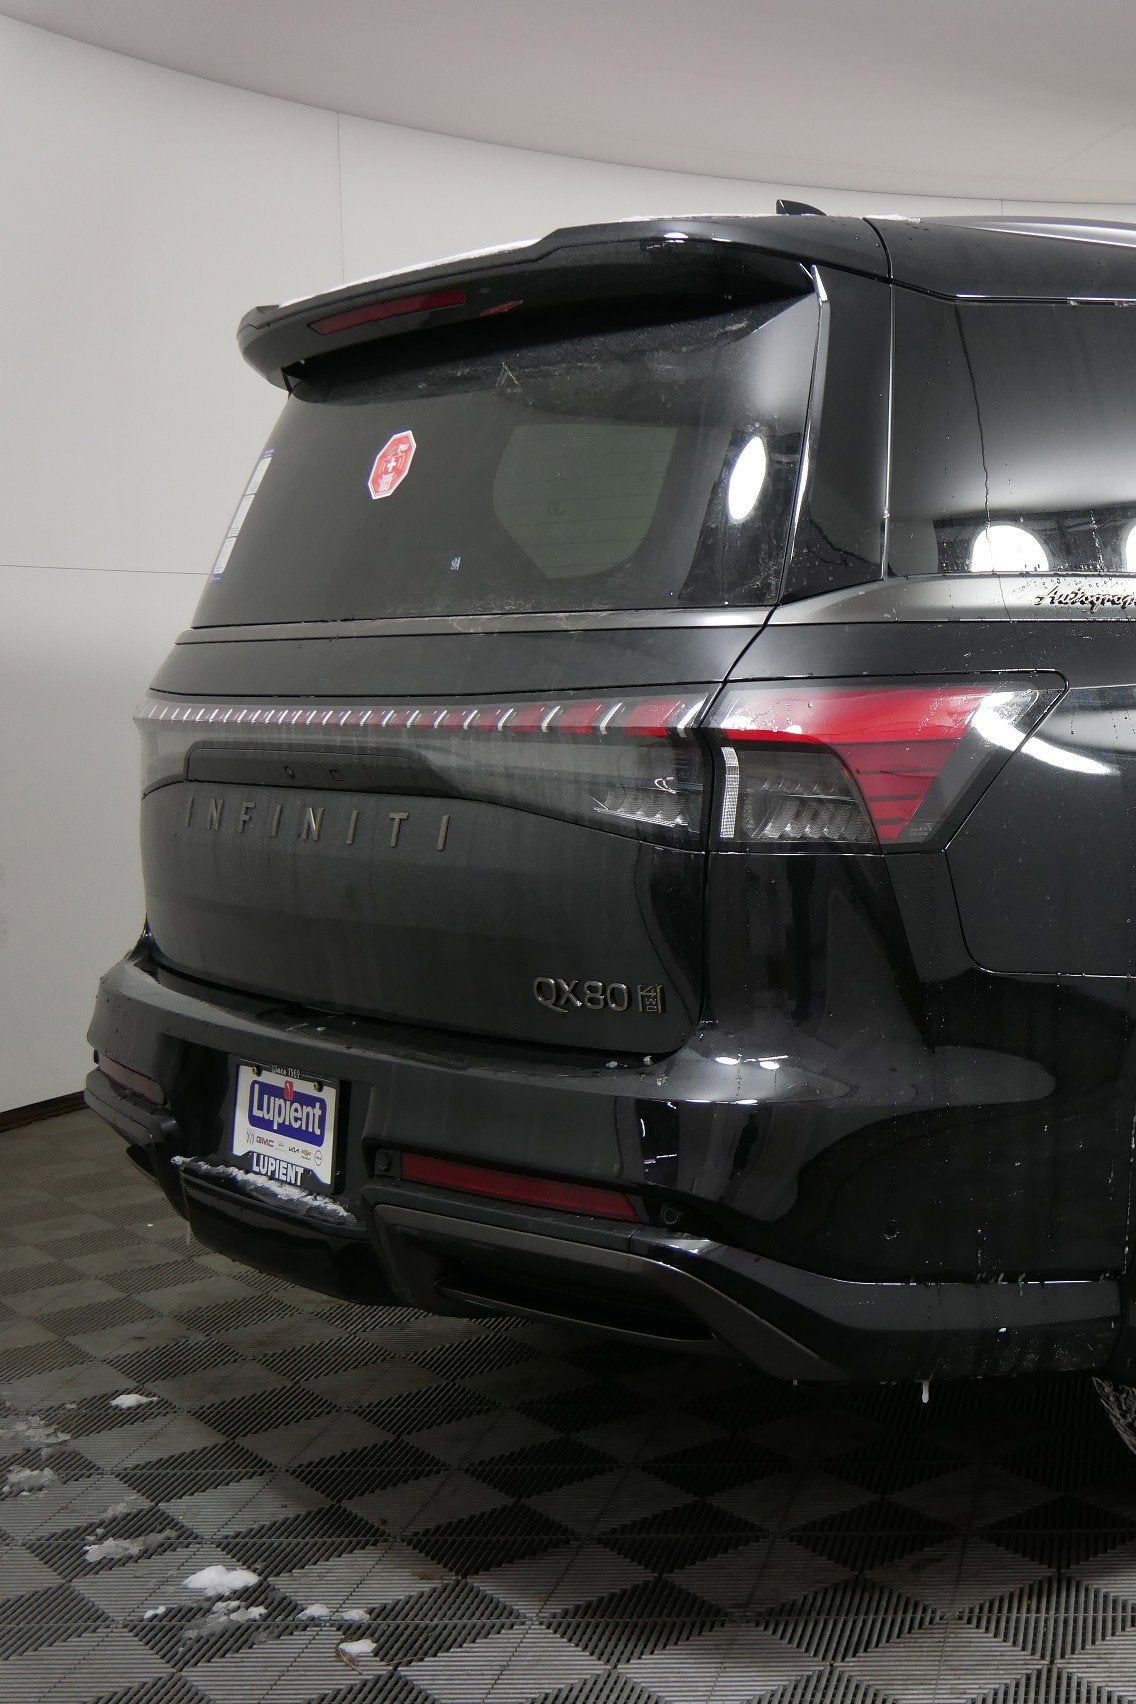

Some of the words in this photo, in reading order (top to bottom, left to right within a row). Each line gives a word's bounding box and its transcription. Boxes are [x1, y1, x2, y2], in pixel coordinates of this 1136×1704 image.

[185, 796, 450, 851] INFINITI
[533, 977, 629, 1013] QX80
[253, 1083, 322, 1135] Lupient
[256, 1135, 274, 1147] GMC
[252, 1152, 304, 1185] LUPIENT
